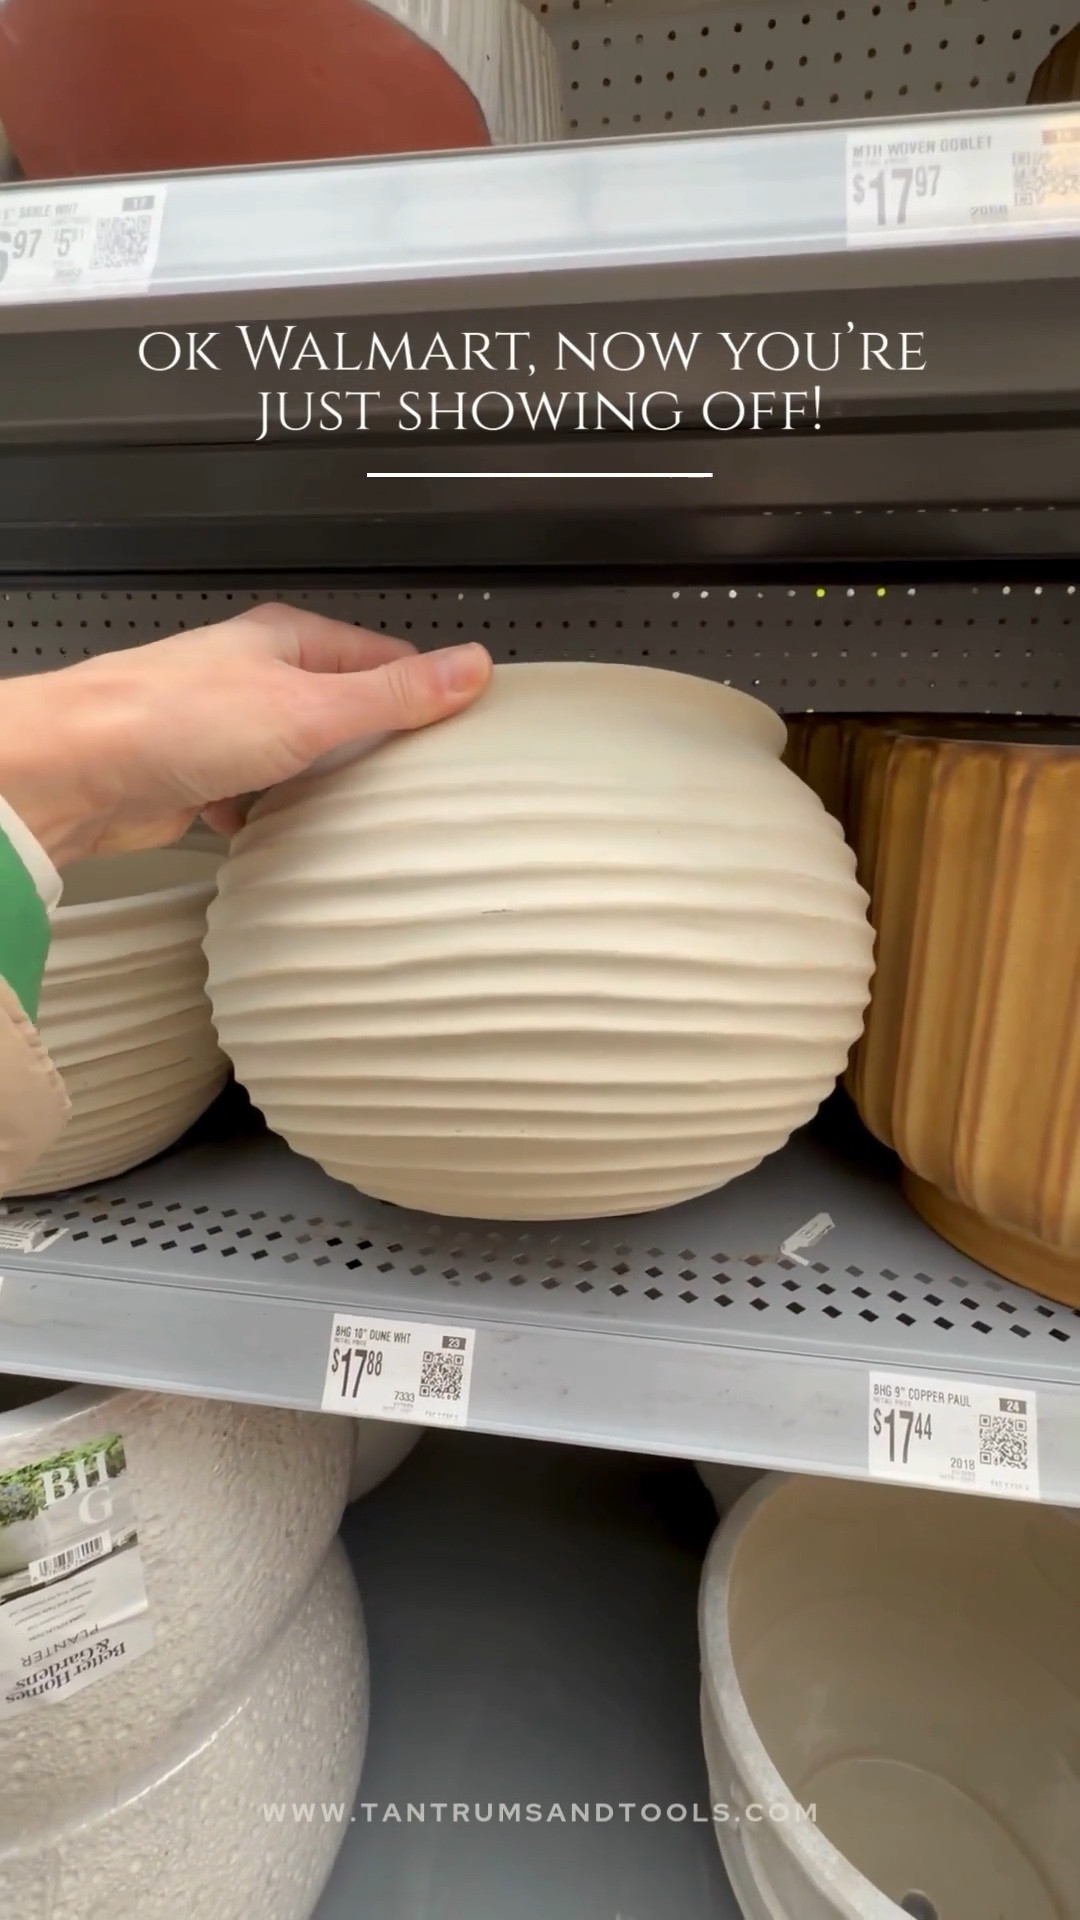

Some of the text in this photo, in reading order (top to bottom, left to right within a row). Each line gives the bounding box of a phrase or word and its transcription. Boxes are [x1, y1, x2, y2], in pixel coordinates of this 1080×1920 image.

[887, 140, 936, 155] WOVEN
[335, 1325, 351, 1338] BHG
[369, 1330, 392, 1343] DUNE
[393, 1332, 411, 1344] WHT
[448, 1337, 460, 1348] 23
[394, 1390, 415, 1402] 7333
[873, 1383, 892, 1398] BHG
[908, 1387, 945, 1404] COPPER
[948, 1393, 972, 1408] PAUL
[1006, 1400, 1020, 1412] 24
[950, 1457, 976, 1470] 2018
[20, 1622, 99, 1667] PLANTER
[5, 1641, 126, 1704] Better Homes
[16, 1646, 94, 1689] Gardens
